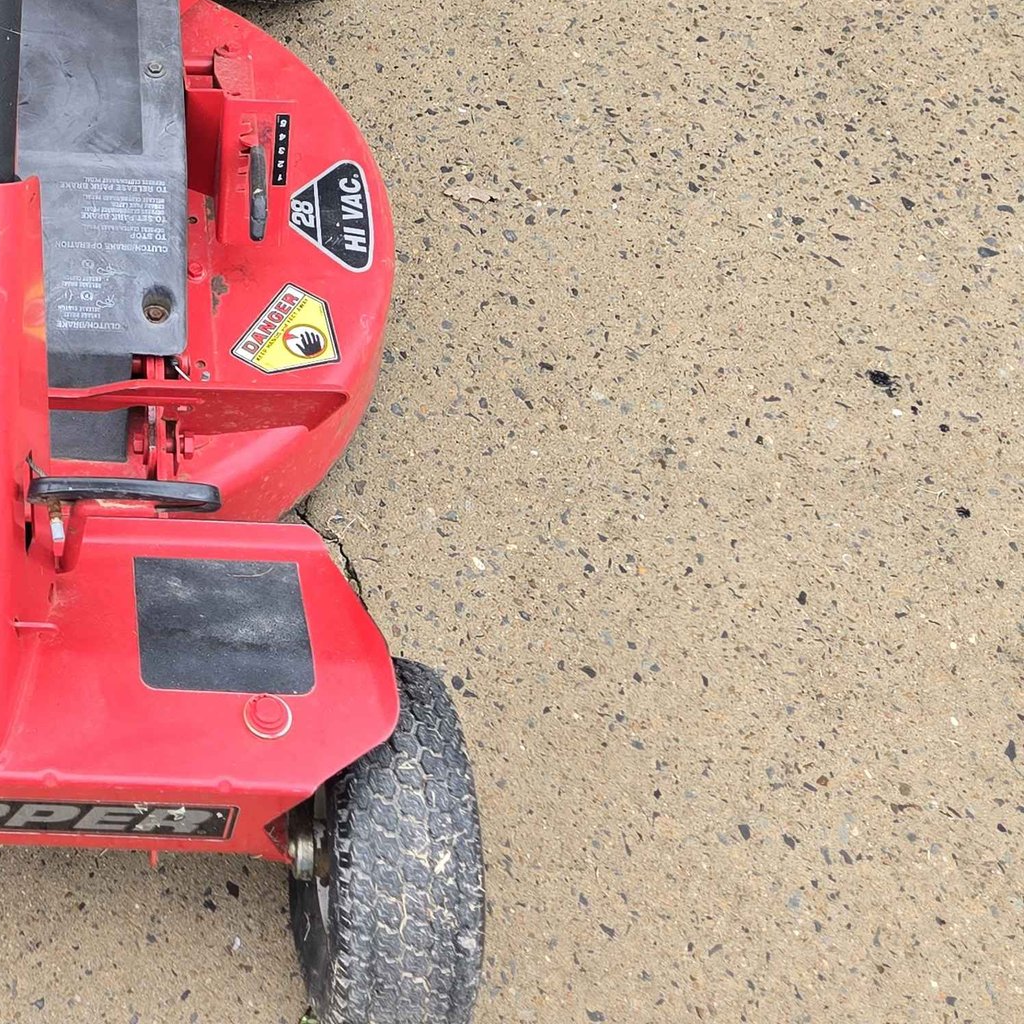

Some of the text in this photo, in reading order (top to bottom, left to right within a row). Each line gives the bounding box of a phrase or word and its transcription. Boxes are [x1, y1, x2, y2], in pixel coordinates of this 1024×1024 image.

[280, 119, 287, 127] 5
[90, 183, 114, 191] PARK
[116, 184, 154, 192] RELEASE
[81, 212, 109, 220] BRAKE
[291, 199, 315, 227] 28
[130, 232, 153, 240] STOP
[343, 226, 367, 252] HI
[55, 241, 102, 249] OPERATION
[241, 293, 299, 354] DANGER
